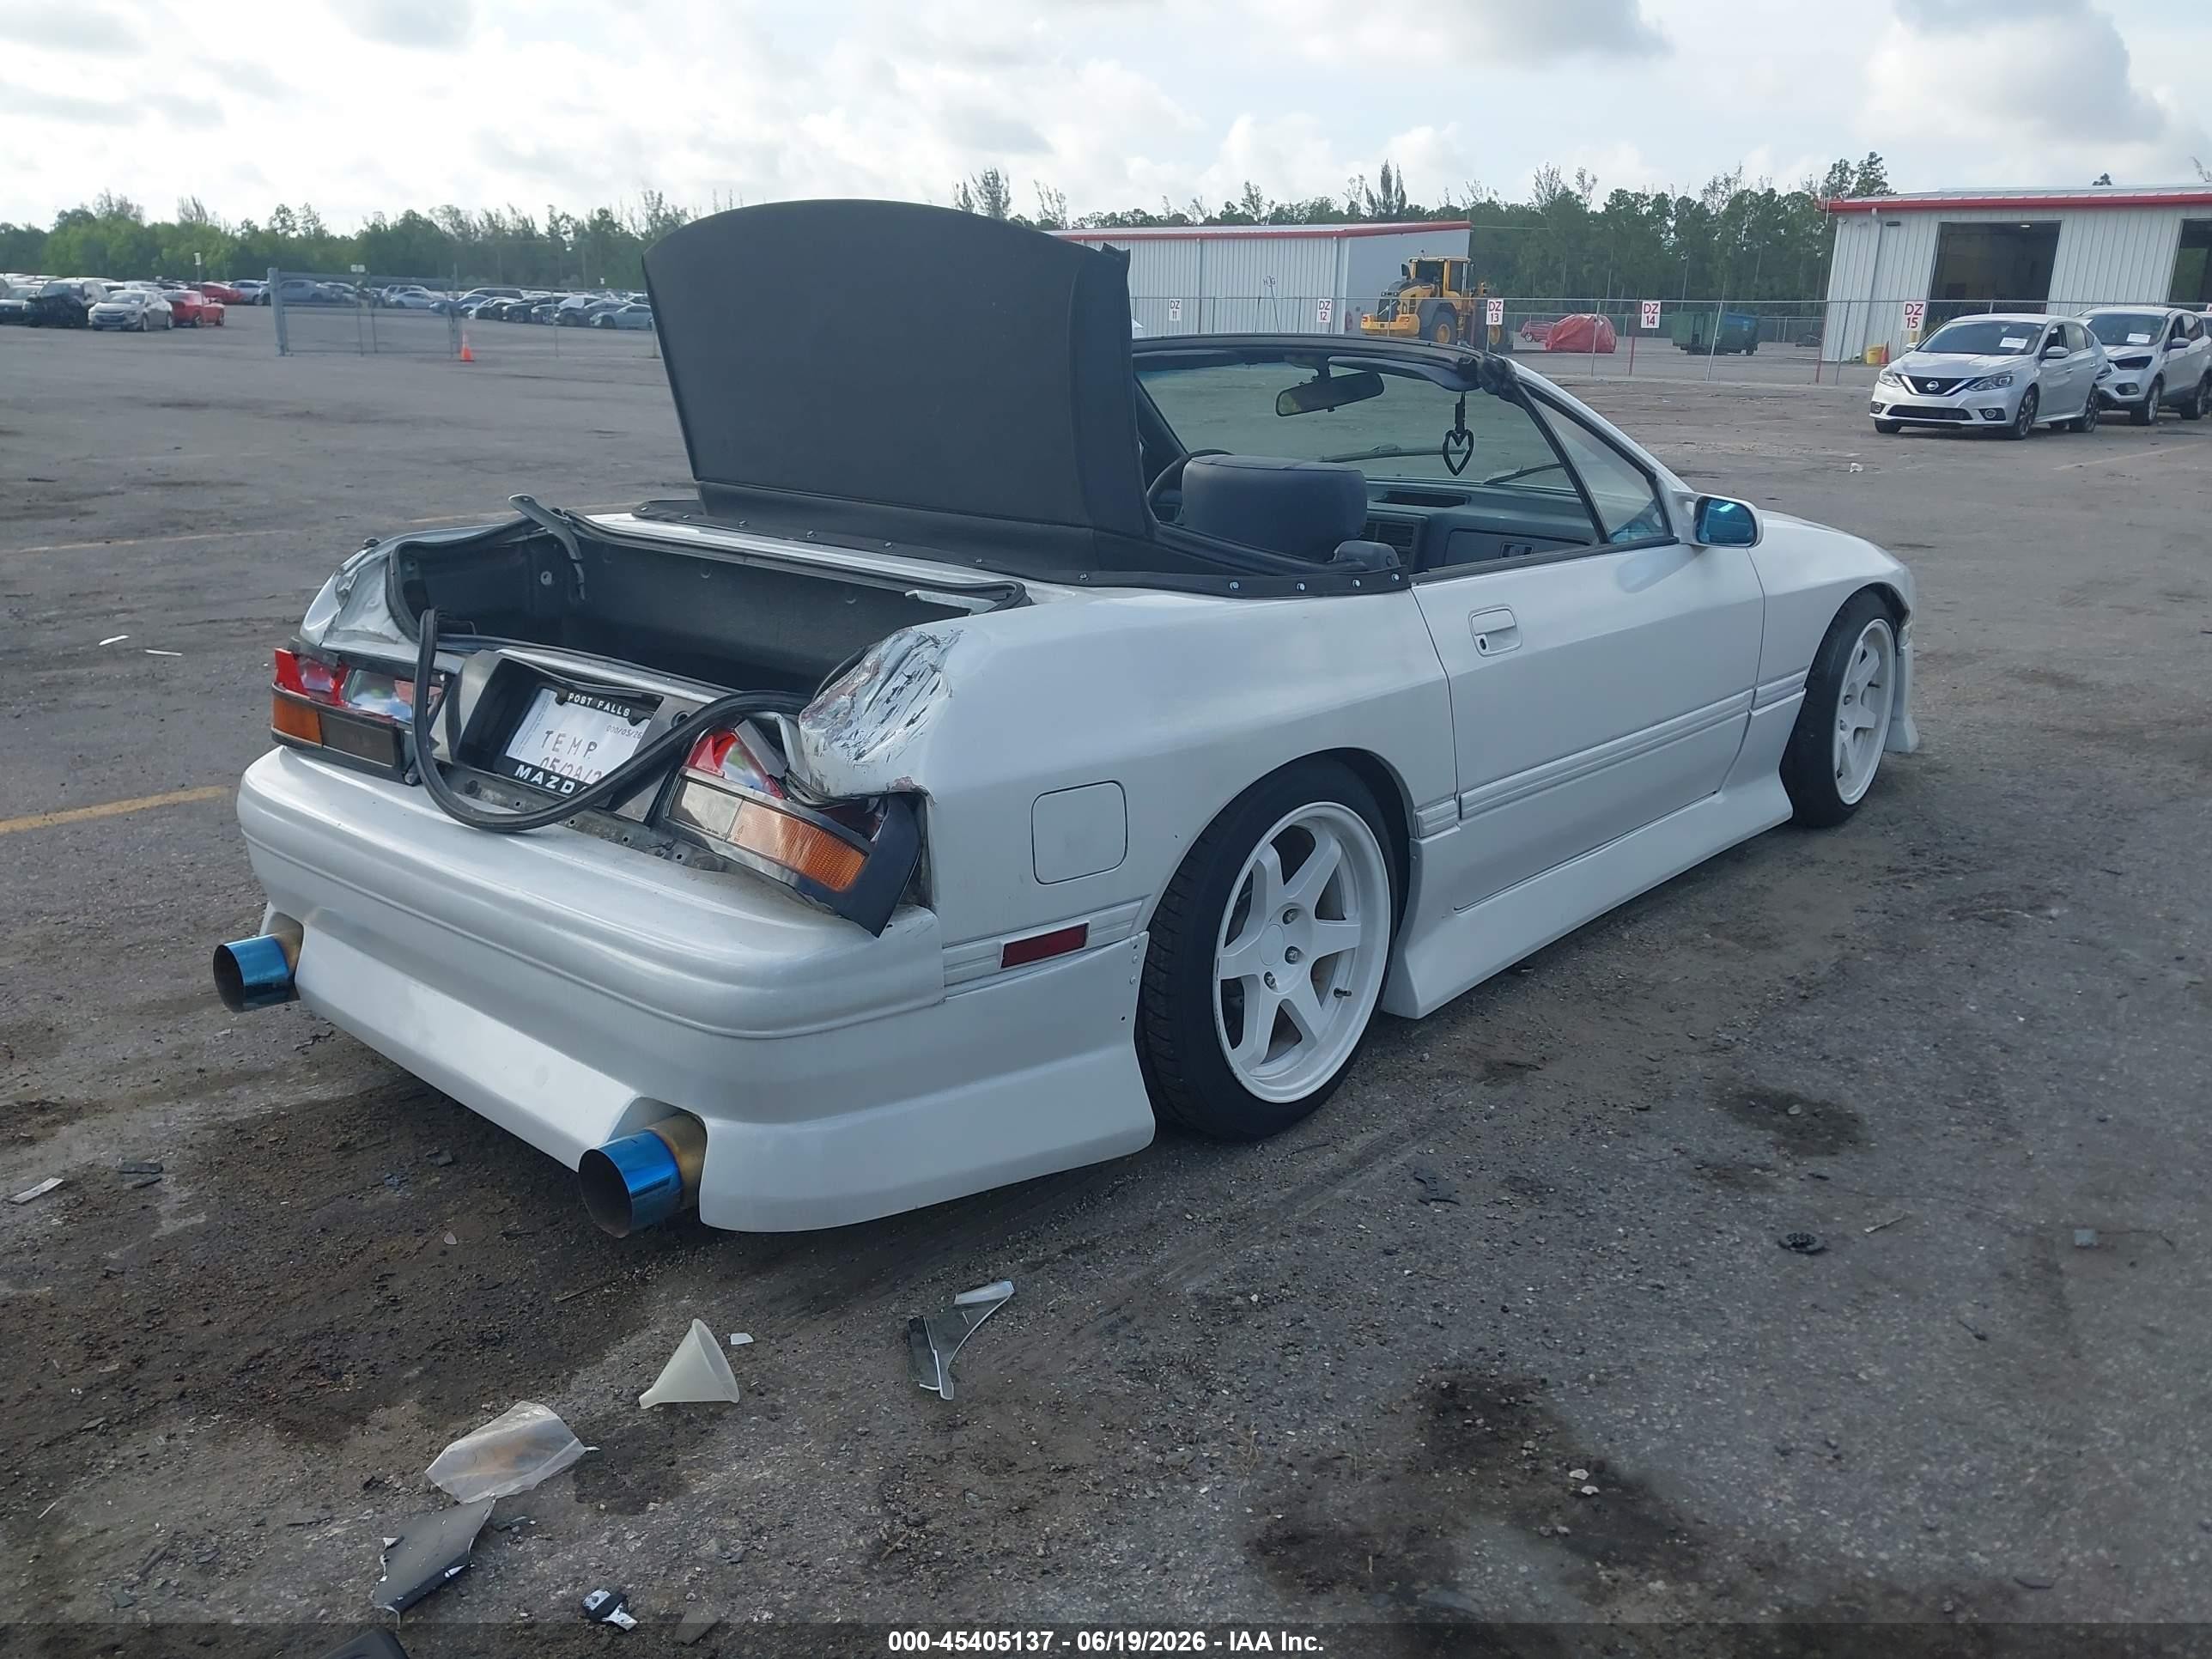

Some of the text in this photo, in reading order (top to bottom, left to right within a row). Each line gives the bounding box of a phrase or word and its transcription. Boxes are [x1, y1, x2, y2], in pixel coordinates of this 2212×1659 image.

[1170, 300, 1181, 309] DZ
[1319, 301, 1331, 310] DZ
[1489, 301, 1503, 312] DZ
[1644, 303, 1659, 313] DZ
[1905, 303, 1924, 316] DZ
[1172, 310, 1177, 319] 11
[1320, 311, 1328, 320] 12
[1490, 313, 1499, 323] 13
[1646, 315, 1656, 326] 14
[1906, 317, 1918, 329] 15
[568, 692, 631, 717] POST FALLS
